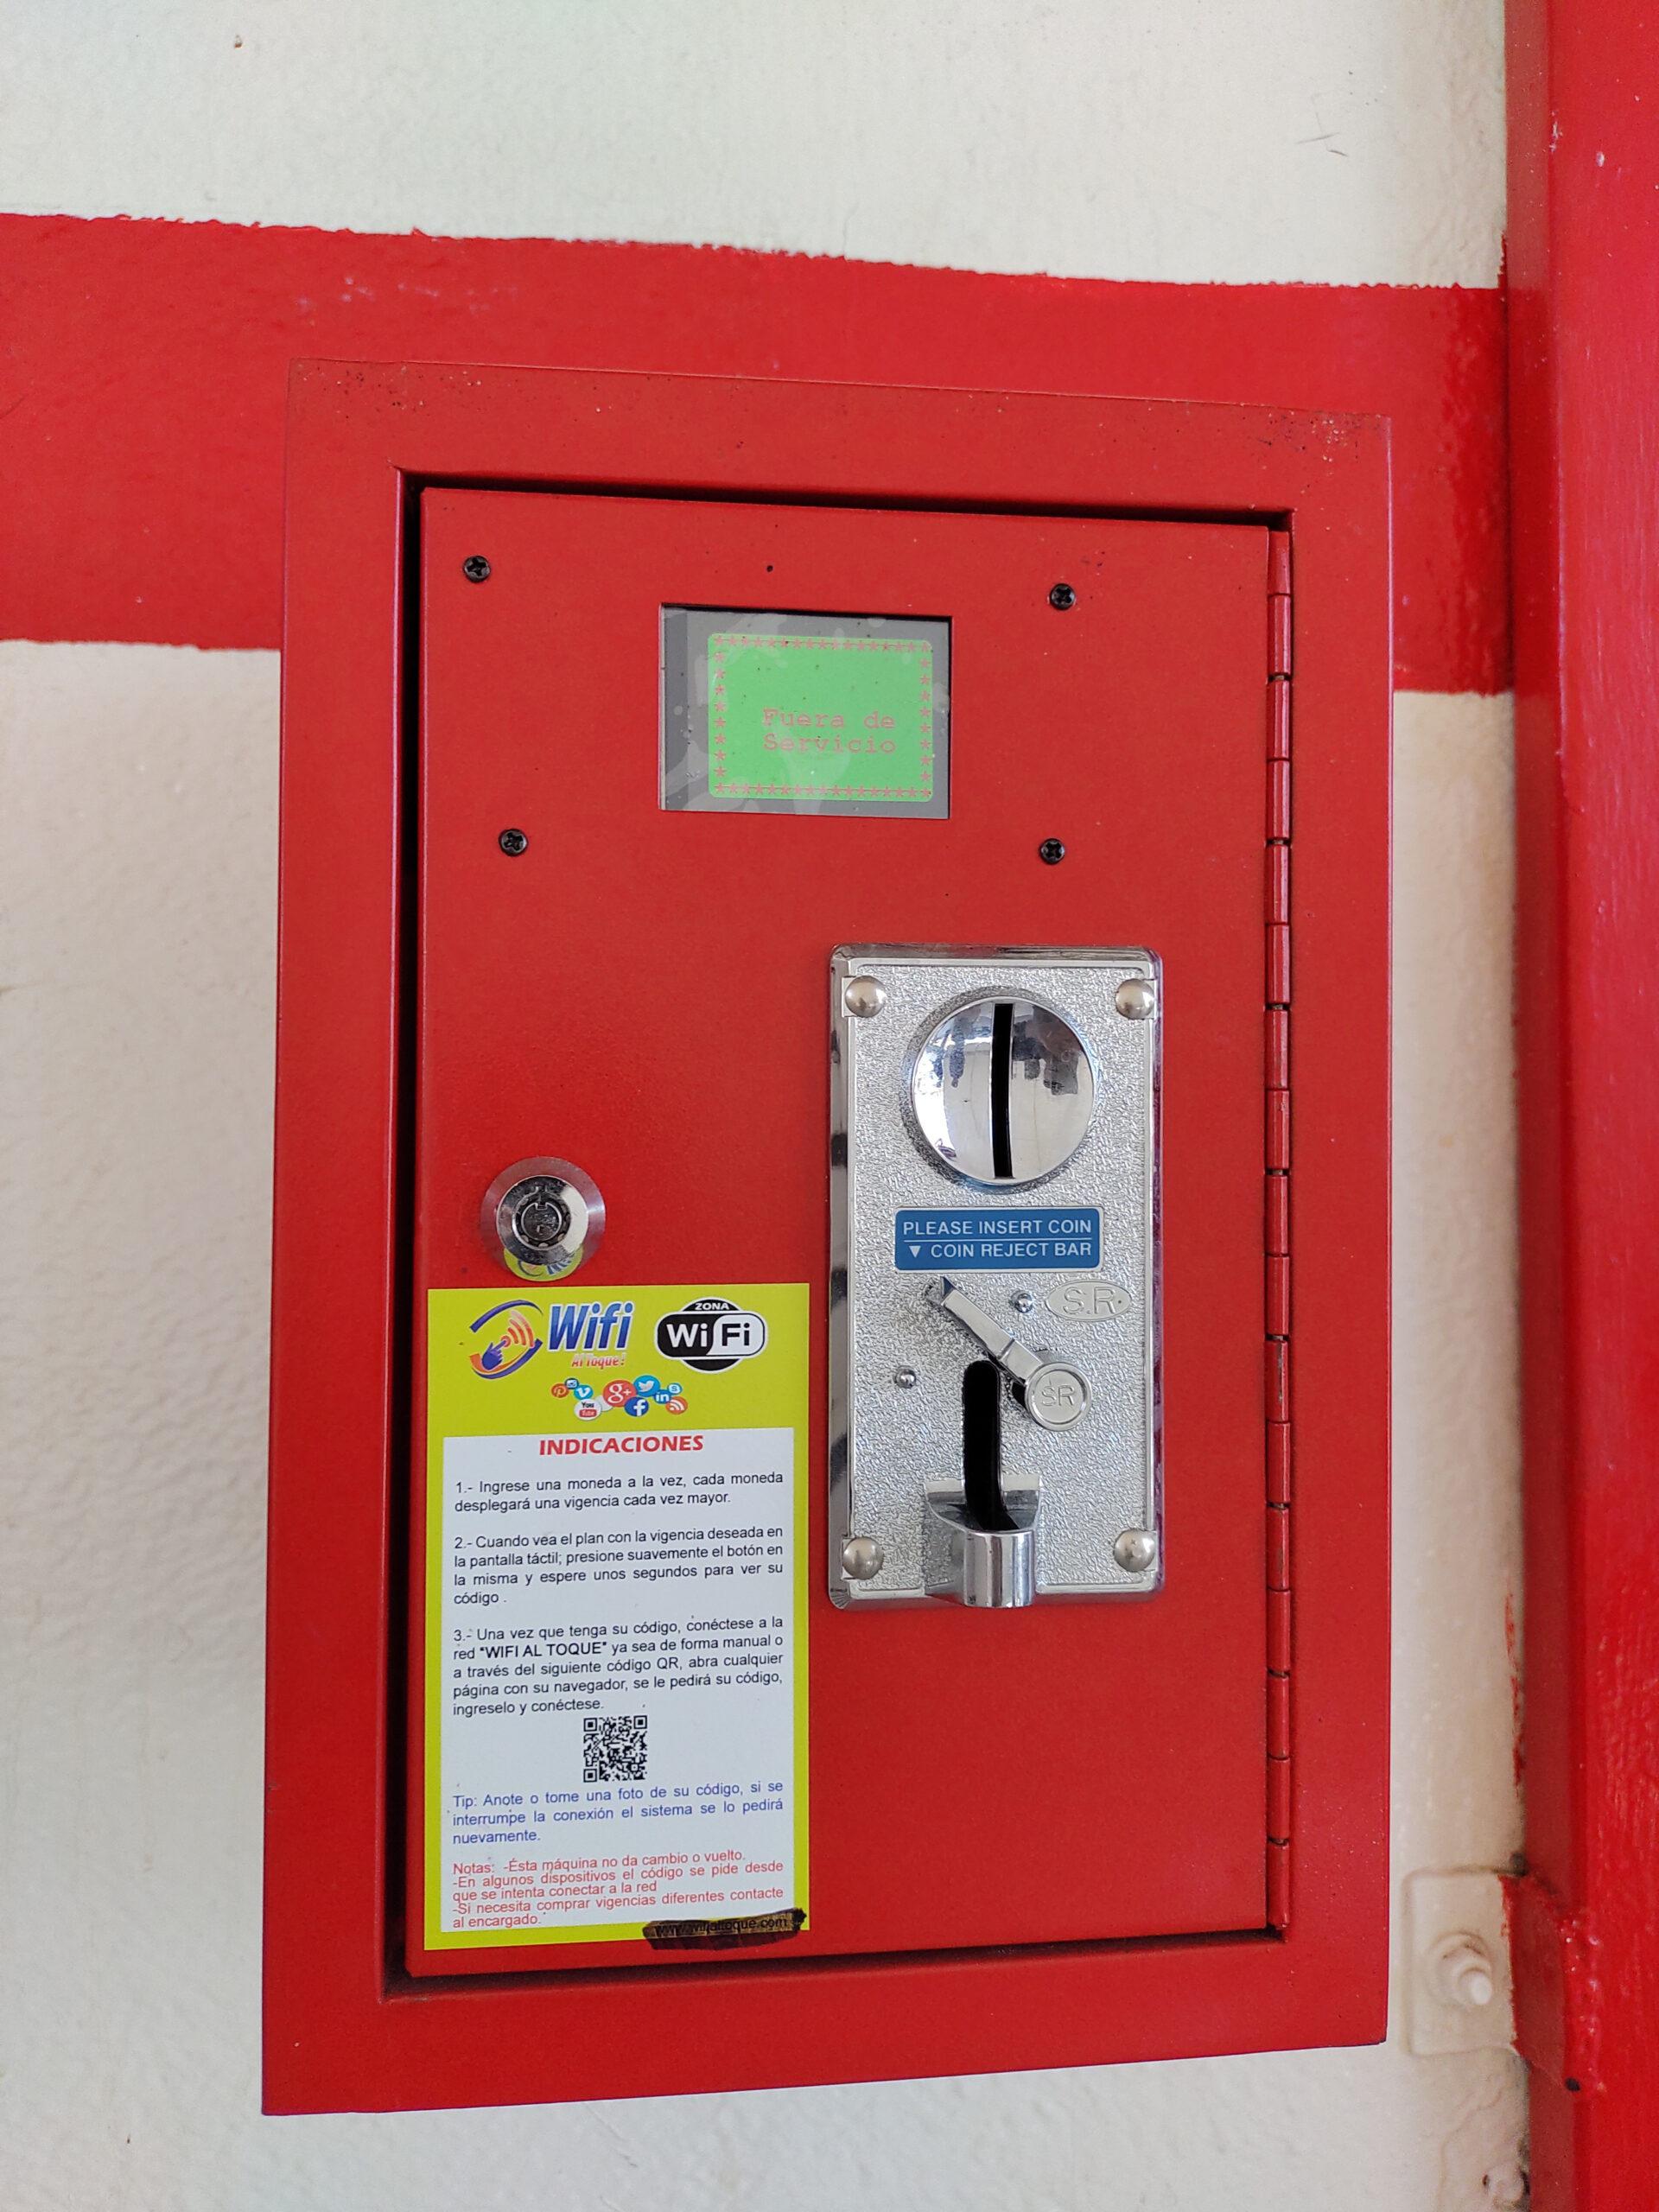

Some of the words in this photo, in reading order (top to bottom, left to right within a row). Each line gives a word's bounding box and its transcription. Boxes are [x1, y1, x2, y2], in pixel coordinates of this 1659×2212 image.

[762, 709, 845, 729] Fuera
[864, 711, 897, 729] de
[763, 734, 897, 753] Servicio
[903, 1220, 972, 1235] PLEASE
[978, 1220, 1044, 1235] INSERT
[1047, 1219, 1092, 1234] COIN
[931, 1244, 975, 1258] COIN
[981, 1243, 1049, 1257] REJECT
[1054, 1243, 1091, 1256] BAR
[695, 1301, 729, 1311] ZONA
[548, 1301, 634, 1351] Wifi
[666, 1321, 751, 1348] WiFi
[571, 1355, 586, 1367] Al
[539, 1435, 703, 1455] INDICACIONES
[456, 1482, 473, 1494] 1.-
[479, 1480, 530, 1495] Ingrese
[537, 1480, 561, 1491] una
[568, 1477, 622, 1490] moneda
[628, 1479, 636, 1488] a
[642, 1476, 654, 1487] la
[660, 1477, 687, 1488] vez,
[693, 1473, 725, 1485] cada
[731, 1471, 783, 1484] moneda
[454, 1497, 530, 1514] desplegará
[535, 1499, 560, 1509] una
[564, 1496, 620, 1510] vigencia
[623, 1494, 656, 1506] cada
[660, 1496, 683, 1504] vez
[688, 1492, 731, 1506] mayor.
[454, 1537, 473, 1548] 2.-
[476, 1535, 530, 1548] Cuando
[533, 1535, 556, 1546] vea
[561, 1533, 573, 1545] el
[575, 1533, 604, 1547] plan
[607, 1534, 631, 1544] con
[635, 1530, 646, 1542] la
[651, 1529, 704, 1544] vigencia
[708, 1526, 764, 1539] deseada
[767, 1528, 783, 1538] en
[454, 1555, 466, 1567] la
[470, 1554, 523, 1569] pantalla
[527, 1552, 563, 1565] táctil;
[566, 1550, 624, 1566] presione
[627, 1547, 709, 1560] suavemente
[712, 1546, 723, 1557] el
[728, 1544, 764, 1556] botón
[767, 1546, 783, 1555] en
[454, 1574, 466, 1586] la
[473, 1573, 518, 1585] misma
[525, 1574, 533, 1586] y
[540, 1572, 586, 1585] espere
[594, 1570, 626, 1580] unos
[633, 1566, 697, 1581] segundos
[704, 1565, 734, 1579] para
[741, 1564, 761, 1574] ver
[768, 1563, 783, 1573] su
[454, 1592, 499, 1606] código
[454, 1629, 472, 1642] 3.-
[477, 1628, 505, 1640] Una
[511, 1630, 534, 1639] vez
[539, 1627, 564, 1640] que
[569, 1625, 607, 1639] tenga
[613, 1624, 628, 1635] su
[633, 1622, 681, 1636] código,
[687, 1618, 753, 1631] conéctese
[759, 1618, 766, 1628] a
[772, 1617, 783, 1628] la
[454, 1648, 475, 1660] red
[523, 1644, 542, 1657] AL
[612, 1643, 627, 1656] ya
[632, 1642, 656, 1652] sea
[660, 1639, 677, 1650] de
[681, 1638, 718, 1649] forma
[723, 1635, 771, 1648] manual
[775, 1636, 783, 1645] o
[454, 1669, 461, 1678] a
[467, 1664, 509, 1677] través
[515, 1663, 535, 1675] del
[541, 1662, 601, 1676] siguiente
[607, 1658, 651, 1673] código
[657, 1656, 683, 1670] QR,
[689, 1656, 718, 1668] abra
[724, 1654, 783, 1667] cualquier
[453, 1683, 499, 1700] página
[505, 1684, 528, 1694] con
[533, 1683, 549, 1694] su
[554, 1678, 628, 1694] navegador,
[633, 1679, 649, 1689] se
[654, 1676, 664, 1688] le
[671, 1675, 711, 1689] pedirá
[716, 1675, 731, 1685] su
[736, 1672, 783, 1685] código,
[453, 1701, 515, 1718] ingreselo
[519, 1703, 527, 1715] y
[531, 1698, 604, 1712] conéctese.
[454, 1796, 477, 1809] Tip:
[483, 1794, 523, 1807] Anote
[530, 1795, 538, 1804] o
[545, 1791, 580, 1803] tome
[587, 1790, 611, 1801] una
[619, 1788, 644, 1800] foto
[651, 1787, 667, 1798] de
[674, 1788, 689, 1797] su
[696, 1783, 743, 1797] código,
[751, 1782, 761, 1793] si
[768, 1782, 783, 1791] se
[453, 1812, 525, 1827] interrumpe
[534, 1810, 545, 1822] la
[554, 1808, 613, 1821] conexión
[621, 1807, 633, 1818] el
[641, 1803, 693, 1817] sistema
[701, 1803, 715, 1814] se
[724, 1802, 735, 1813] lo
[743, 1798, 784, 1815] pedirá
[453, 1830, 540, 1844] nuevamente.
[453, 1863, 494, 1874] Notas:
[504, 1858, 537, 1872] -Ésta
[542, 1858, 598, 1873] máquina
[602, 1857, 618, 1867] no
[622, 1854, 638, 1866] da
[642, 1853, 688, 1866] cambio
[693, 1853, 700, 1862] o
[704, 1850, 745, 1861] vuelto.
[453, 1876, 475, 1888] -En
[482, 1875, 534, 1889] algunos
[541, 1870, 616, 1885] dispositivos
[623, 1868, 633, 1880] el
[641, 1866, 683, 1880] código
[690, 1866, 704, 1875] se
[712, 1863, 738, 1878] pide
[746, 1860, 784, 1873] desde
[453, 1891, 477, 1904] que
[481, 1889, 497, 1900] se
[501, 1886, 544, 1899] intenta
[550, 1885, 605, 1897] conectar
[609, 1885, 617, 1894] a
[621, 1881, 632, 1893] la
[637, 1880, 657, 1891] red
[453, 1904, 471, 1914] -Si
[477, 1901, 531, 1914] necesita
[537, 1899, 589, 1912] comprar
[596, 1894, 656, 1908] vigencias
[662, 1891, 724, 1904] diferentes
[730, 1888, 784, 1901] contacte
[453, 1916, 464, 1928] al
[468, 1913, 541, 1929] encargado.
